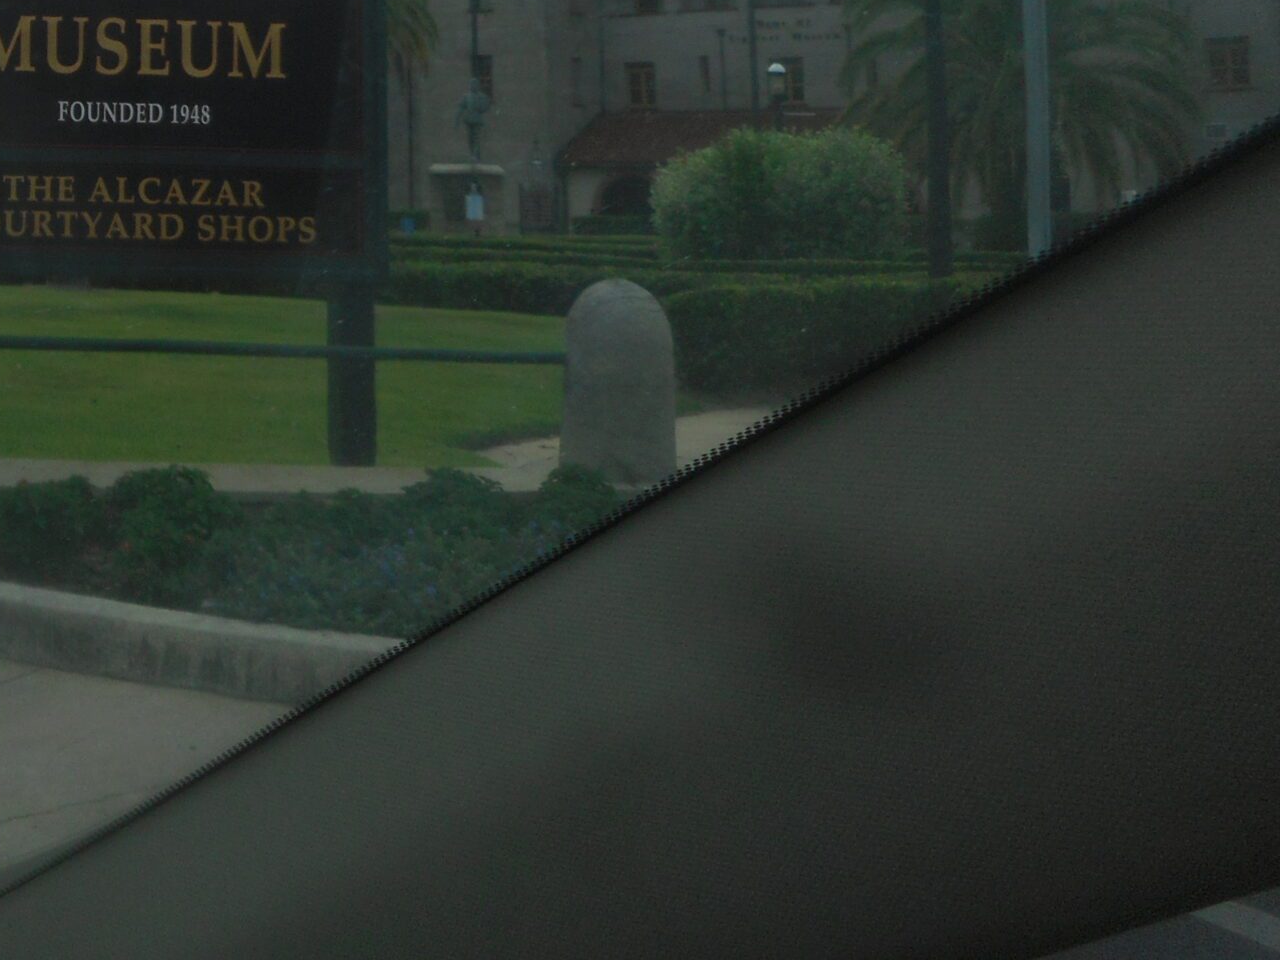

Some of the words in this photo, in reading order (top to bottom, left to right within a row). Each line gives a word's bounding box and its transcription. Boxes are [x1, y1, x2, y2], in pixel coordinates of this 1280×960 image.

[58, 100, 164, 124] FOUNDED
[169, 103, 212, 125] 1948
[2, 174, 76, 204] THE
[88, 176, 265, 208] ALCAZAR
[197, 214, 318, 244] SHOPS
